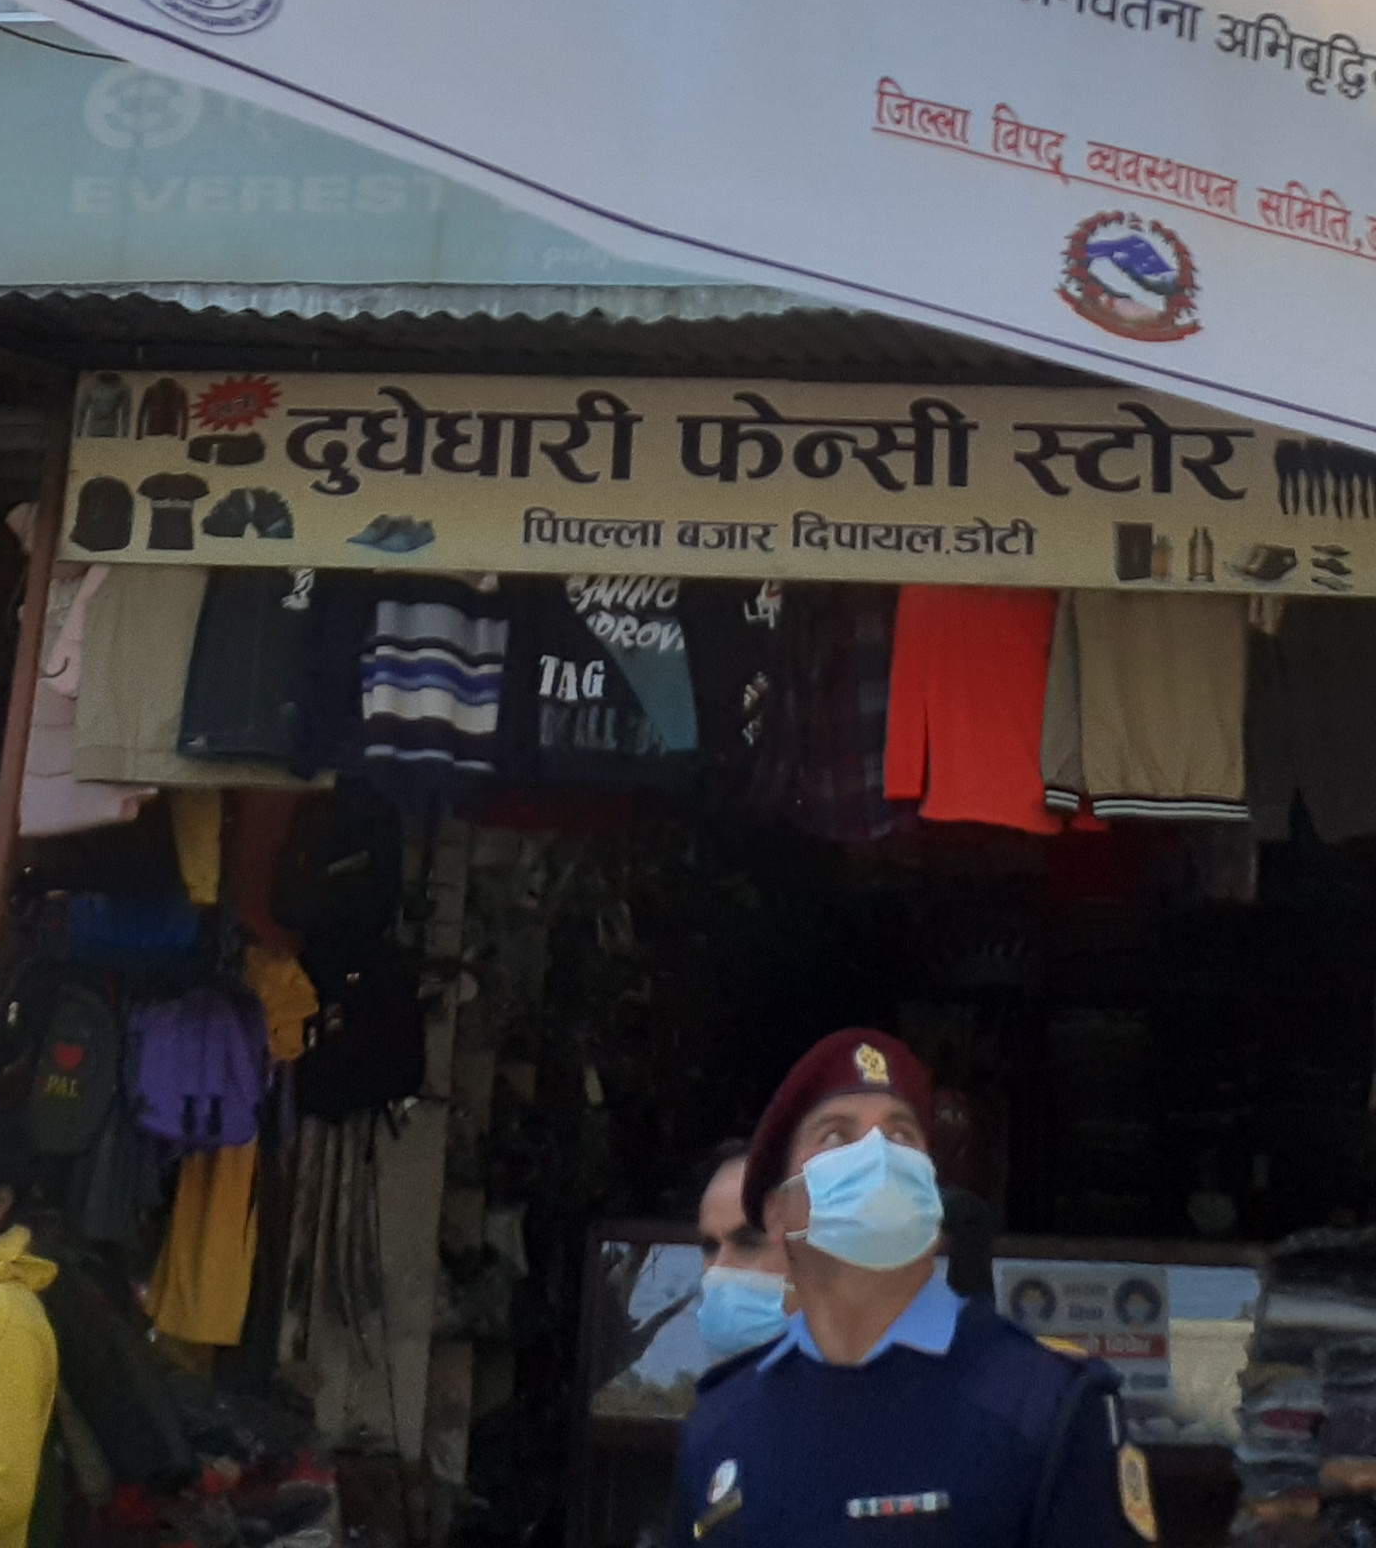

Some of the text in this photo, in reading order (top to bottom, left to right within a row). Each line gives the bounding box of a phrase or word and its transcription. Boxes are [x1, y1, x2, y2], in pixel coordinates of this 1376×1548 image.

[677, 390, 978, 494] फेन्सी
[1013, 401, 1259, 500] स्टोर
[522, 506, 665, 549] पिपल्ला
[676, 520, 778, 554] बजार
[538, 654, 606, 703] TAG
